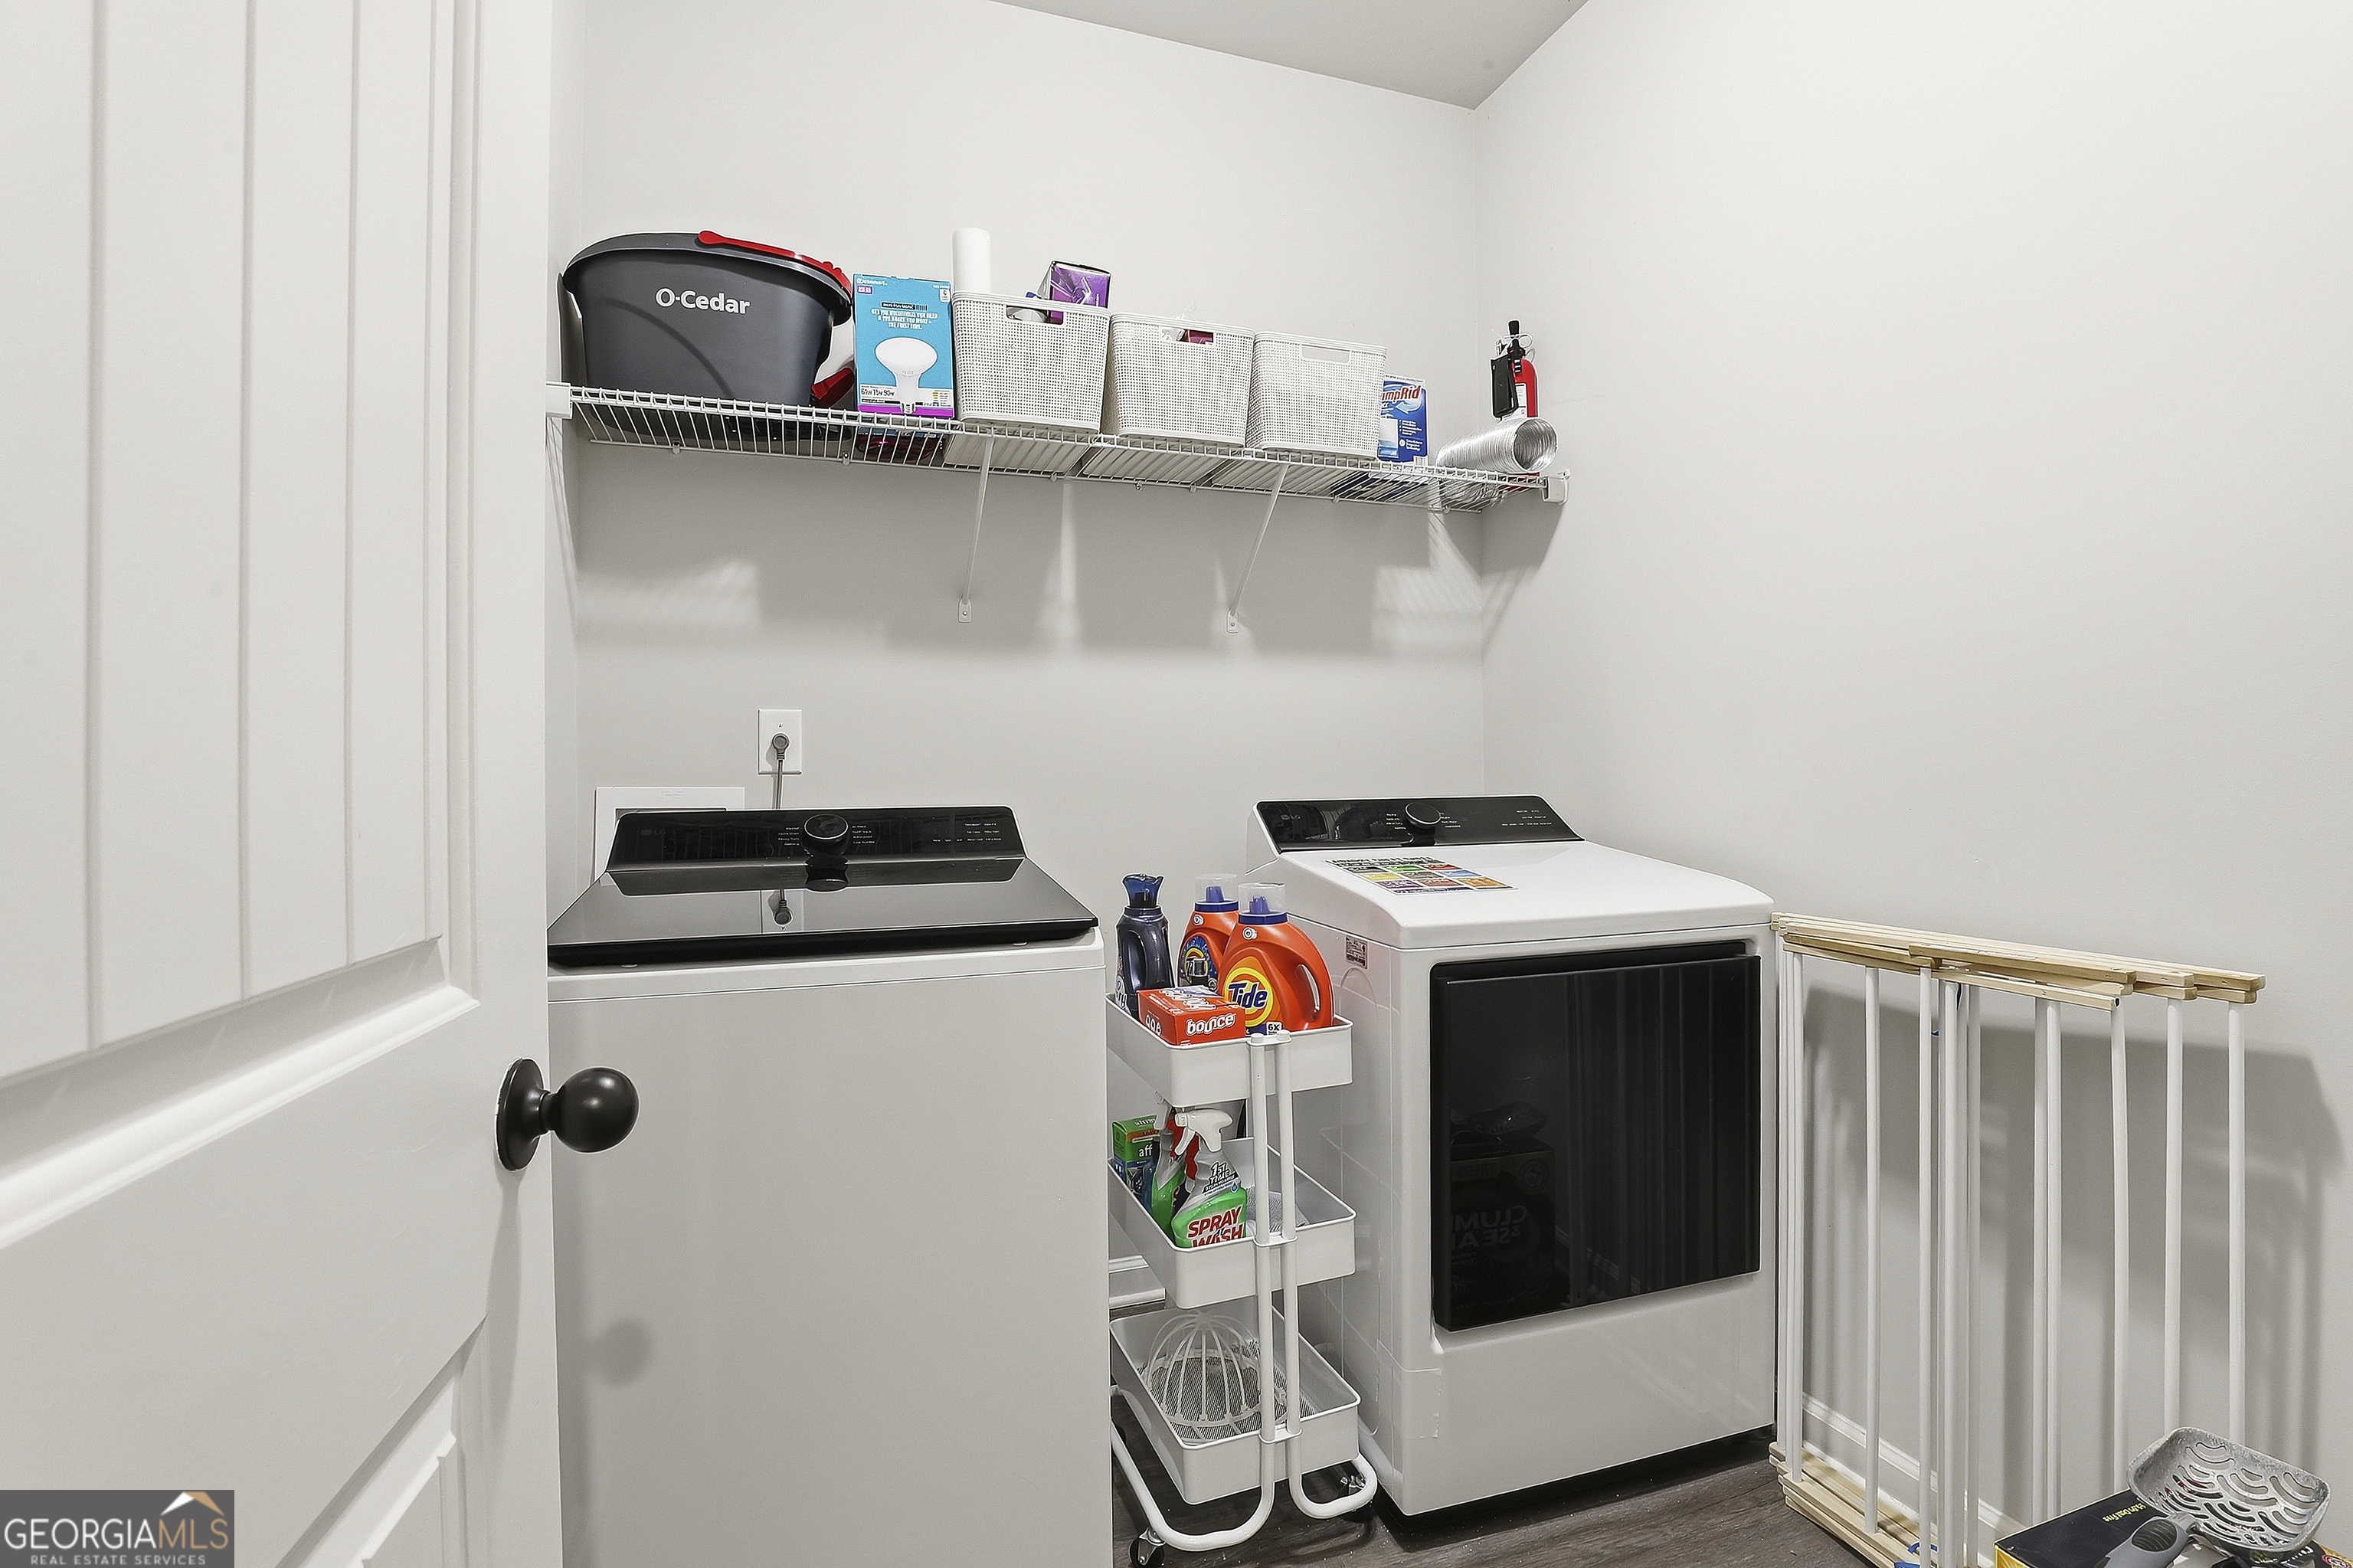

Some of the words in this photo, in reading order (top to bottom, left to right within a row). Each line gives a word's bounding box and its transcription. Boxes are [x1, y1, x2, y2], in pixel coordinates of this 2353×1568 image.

[656, 288, 751, 314] O-Cedar
[1381, 385, 1422, 402] mpRid
[1228, 982, 1268, 1009] Tide
[1186, 1013, 1236, 1036] bounce
[1138, 1144, 1153, 1157] aff
[1187, 1204, 1243, 1239] SPRAY
